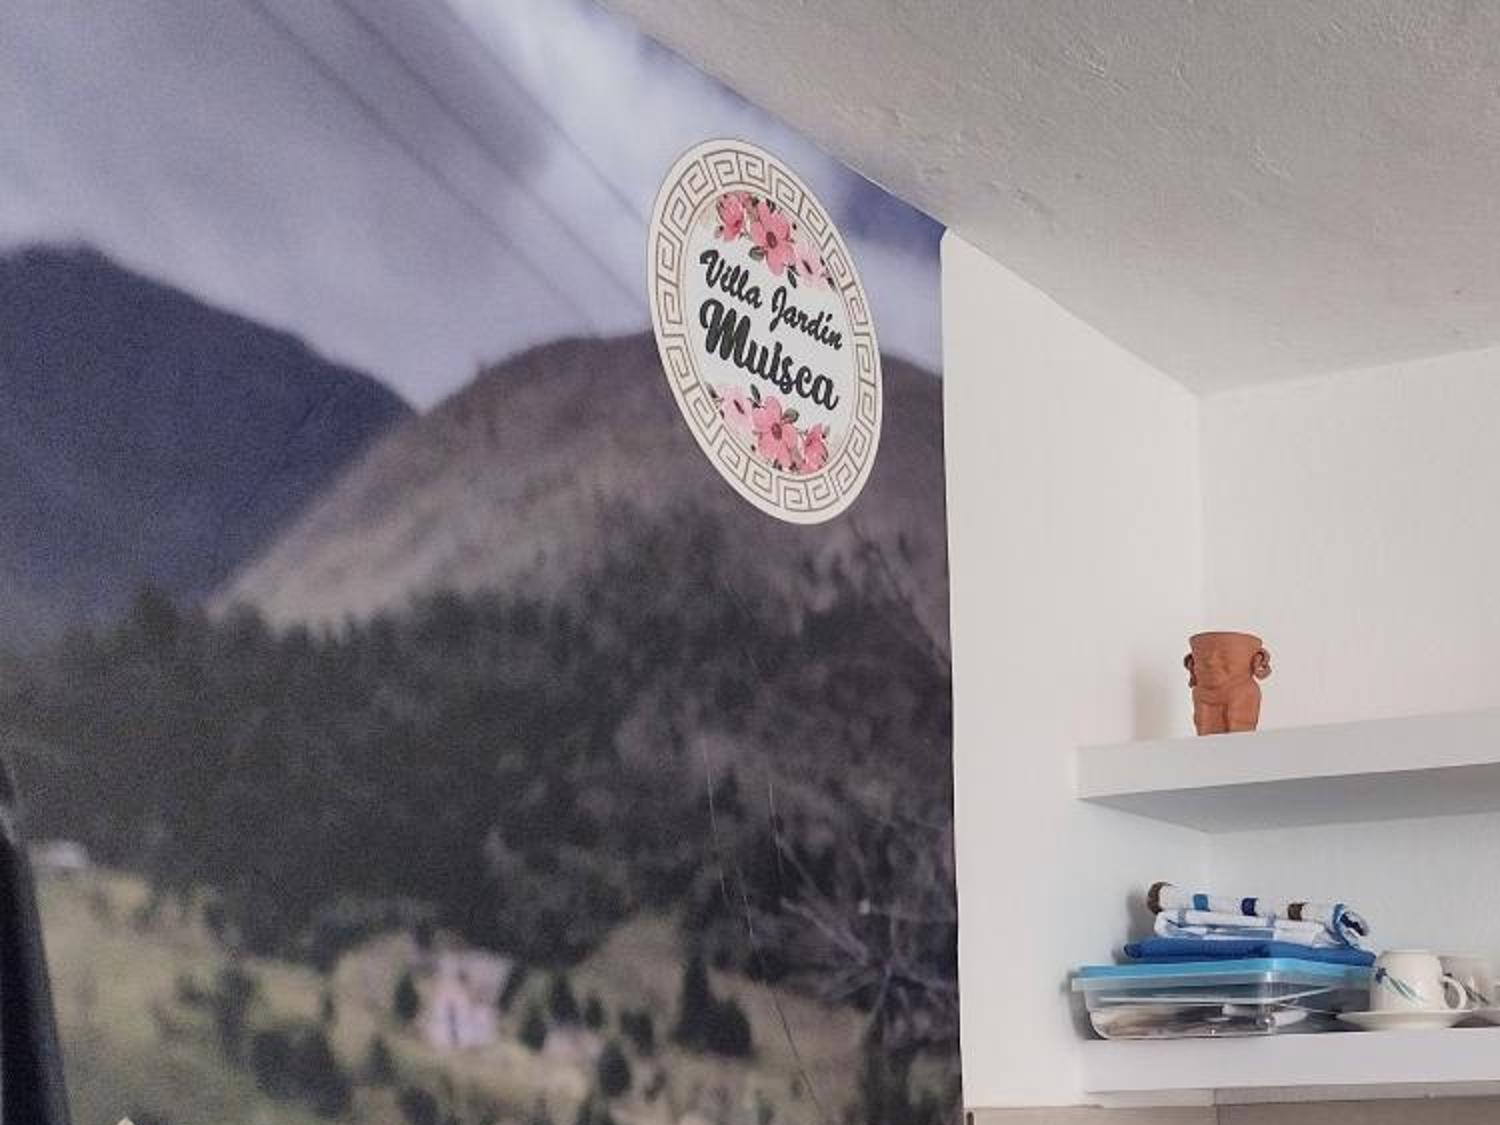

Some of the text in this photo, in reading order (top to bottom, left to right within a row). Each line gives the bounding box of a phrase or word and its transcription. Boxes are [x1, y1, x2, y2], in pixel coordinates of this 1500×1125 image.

[699, 249, 843, 350] Villa Jardín
[699, 298, 840, 411] Muisca
